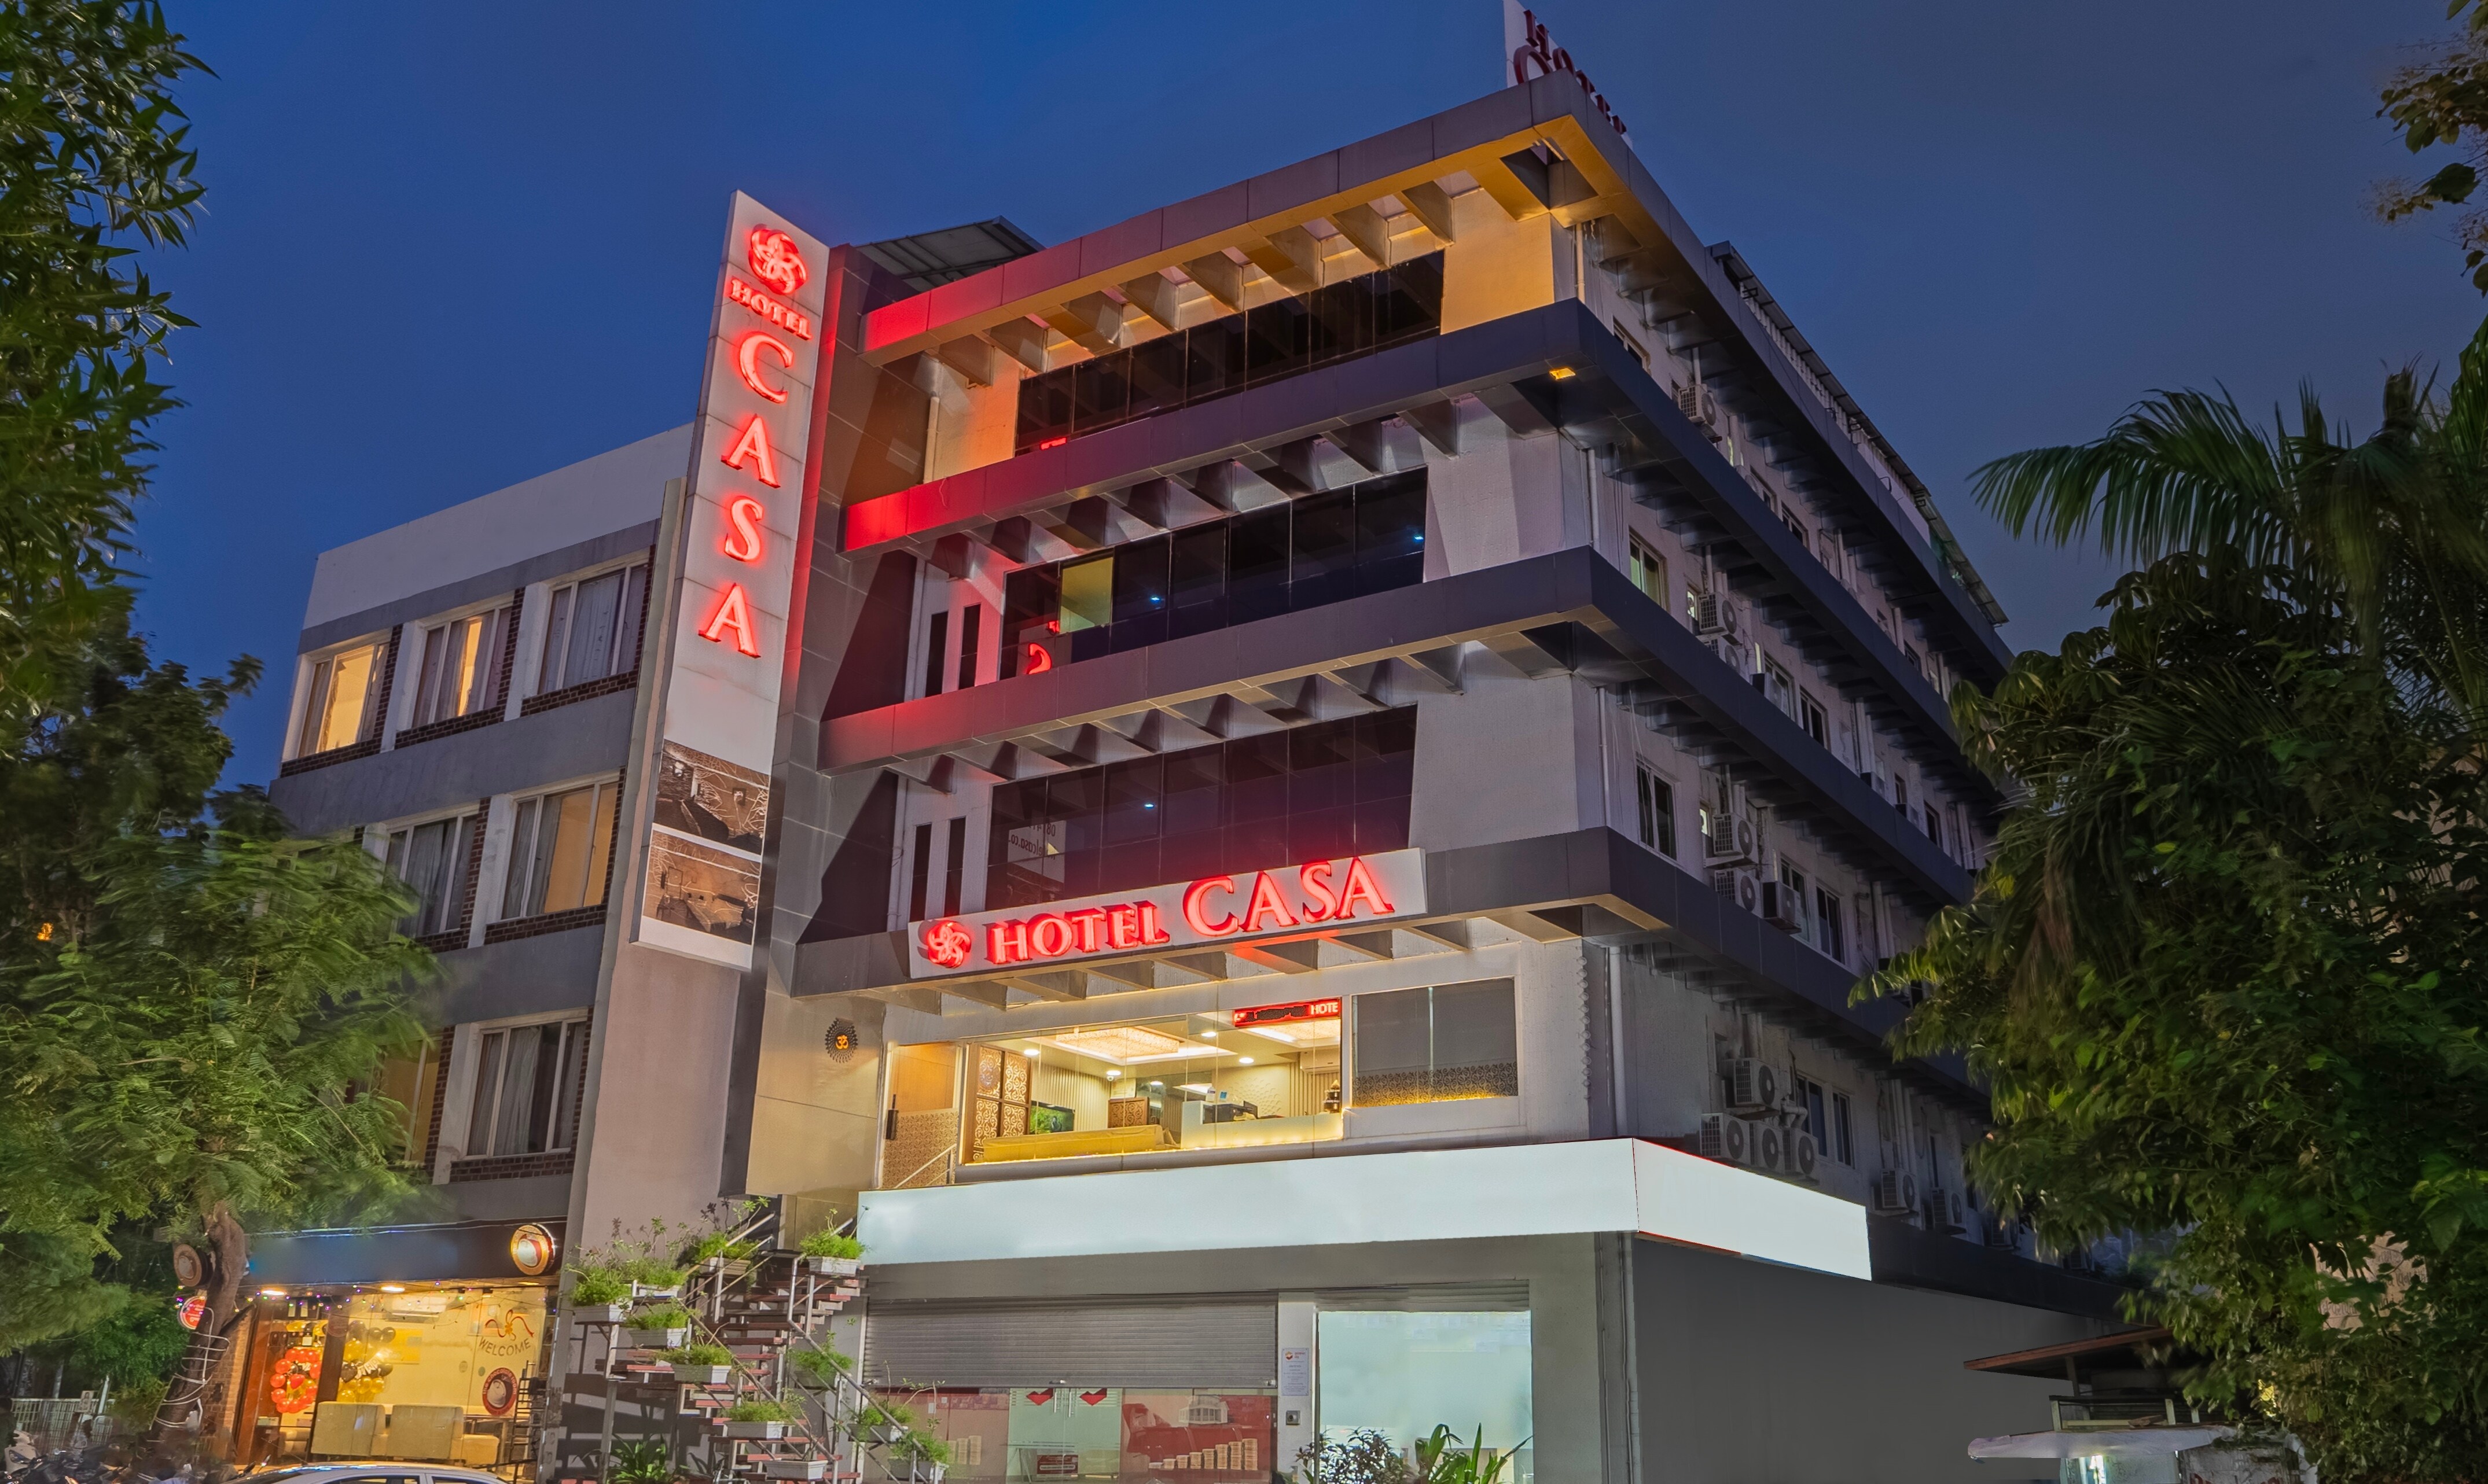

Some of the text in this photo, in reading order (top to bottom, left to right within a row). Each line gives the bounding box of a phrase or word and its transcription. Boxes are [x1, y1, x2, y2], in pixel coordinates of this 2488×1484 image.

[730, 277, 813, 340] HOTEL
[698, 331, 794, 659] CASA
[985, 857, 1395, 964] HOTEL CASA
[479, 1336, 531, 1357] WELCOME
